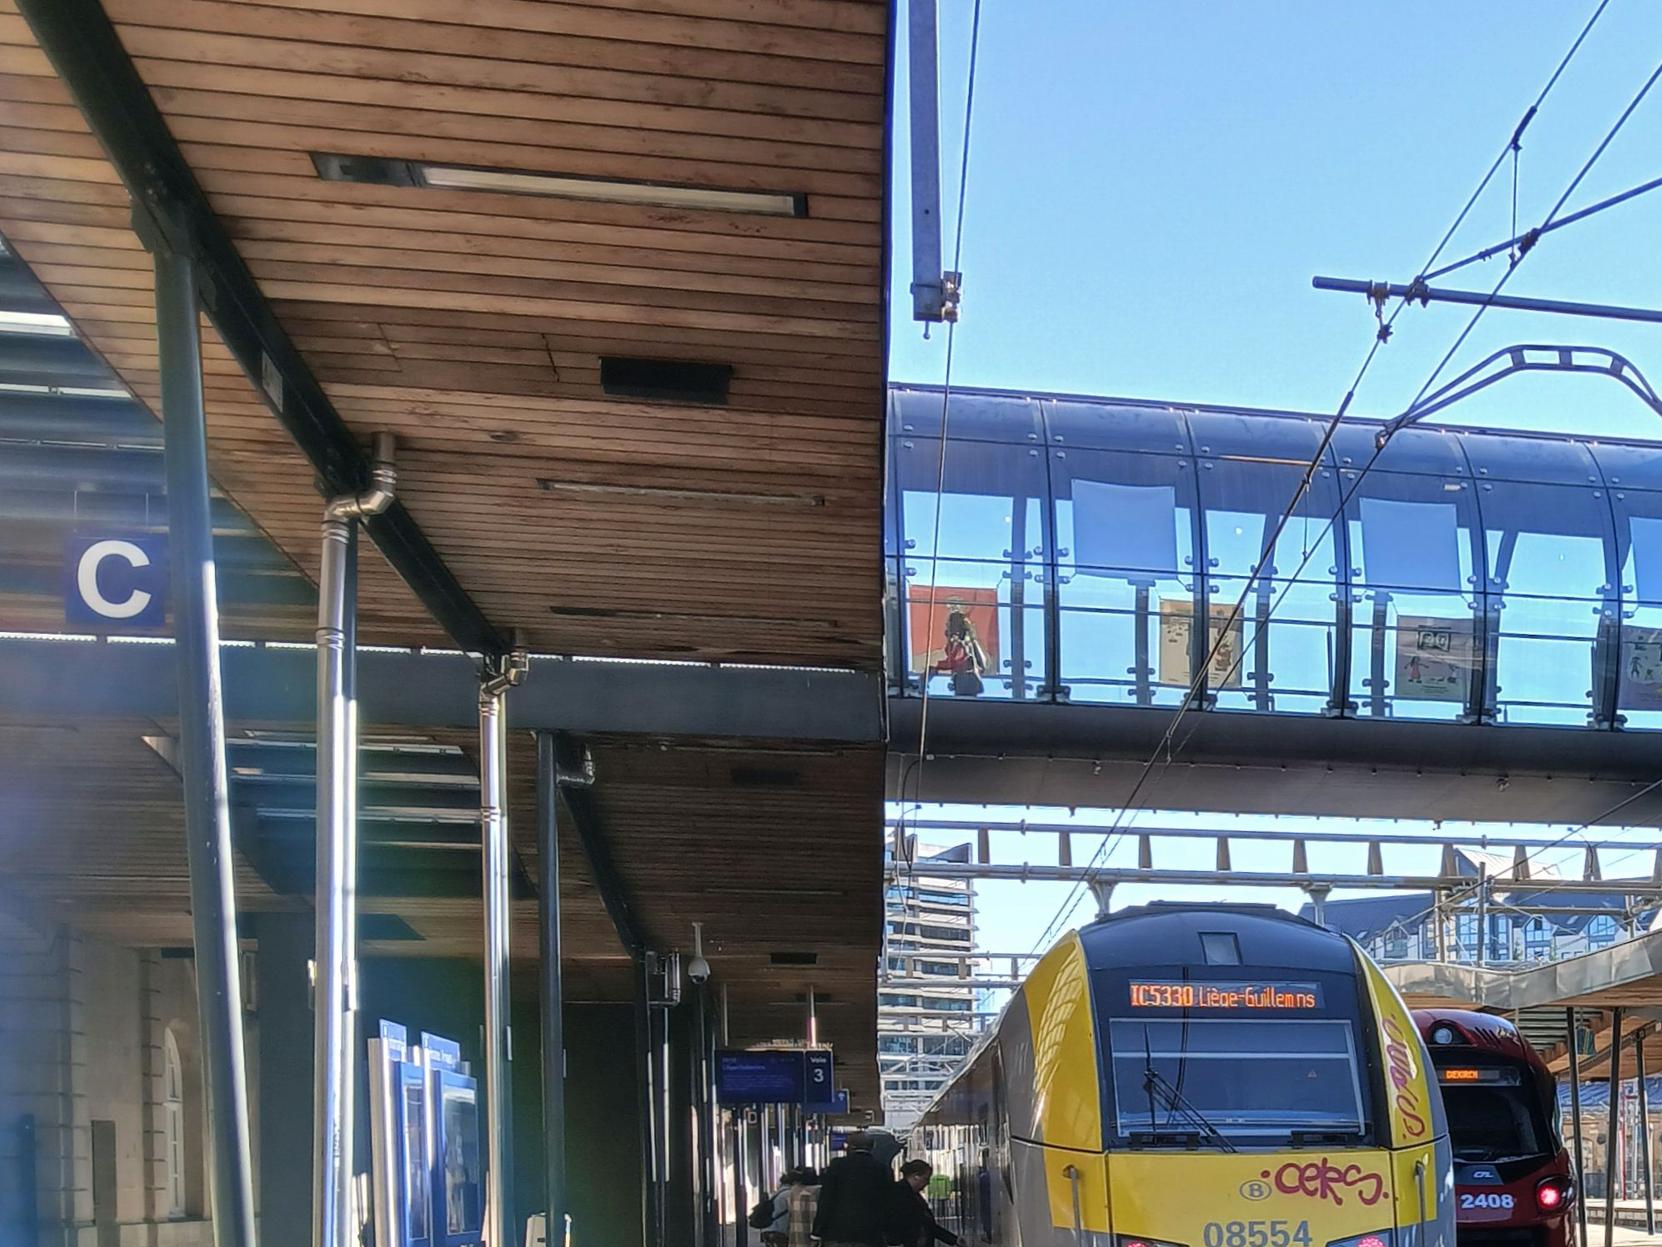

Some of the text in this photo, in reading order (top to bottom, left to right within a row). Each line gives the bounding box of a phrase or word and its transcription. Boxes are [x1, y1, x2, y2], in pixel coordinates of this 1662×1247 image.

[77, 539, 152, 618] C
[1131, 985, 1316, 1009] IC5330 Liège-Guillemns
[814, 1068, 824, 1082] 3
[1460, 1194, 1514, 1209] 2408
